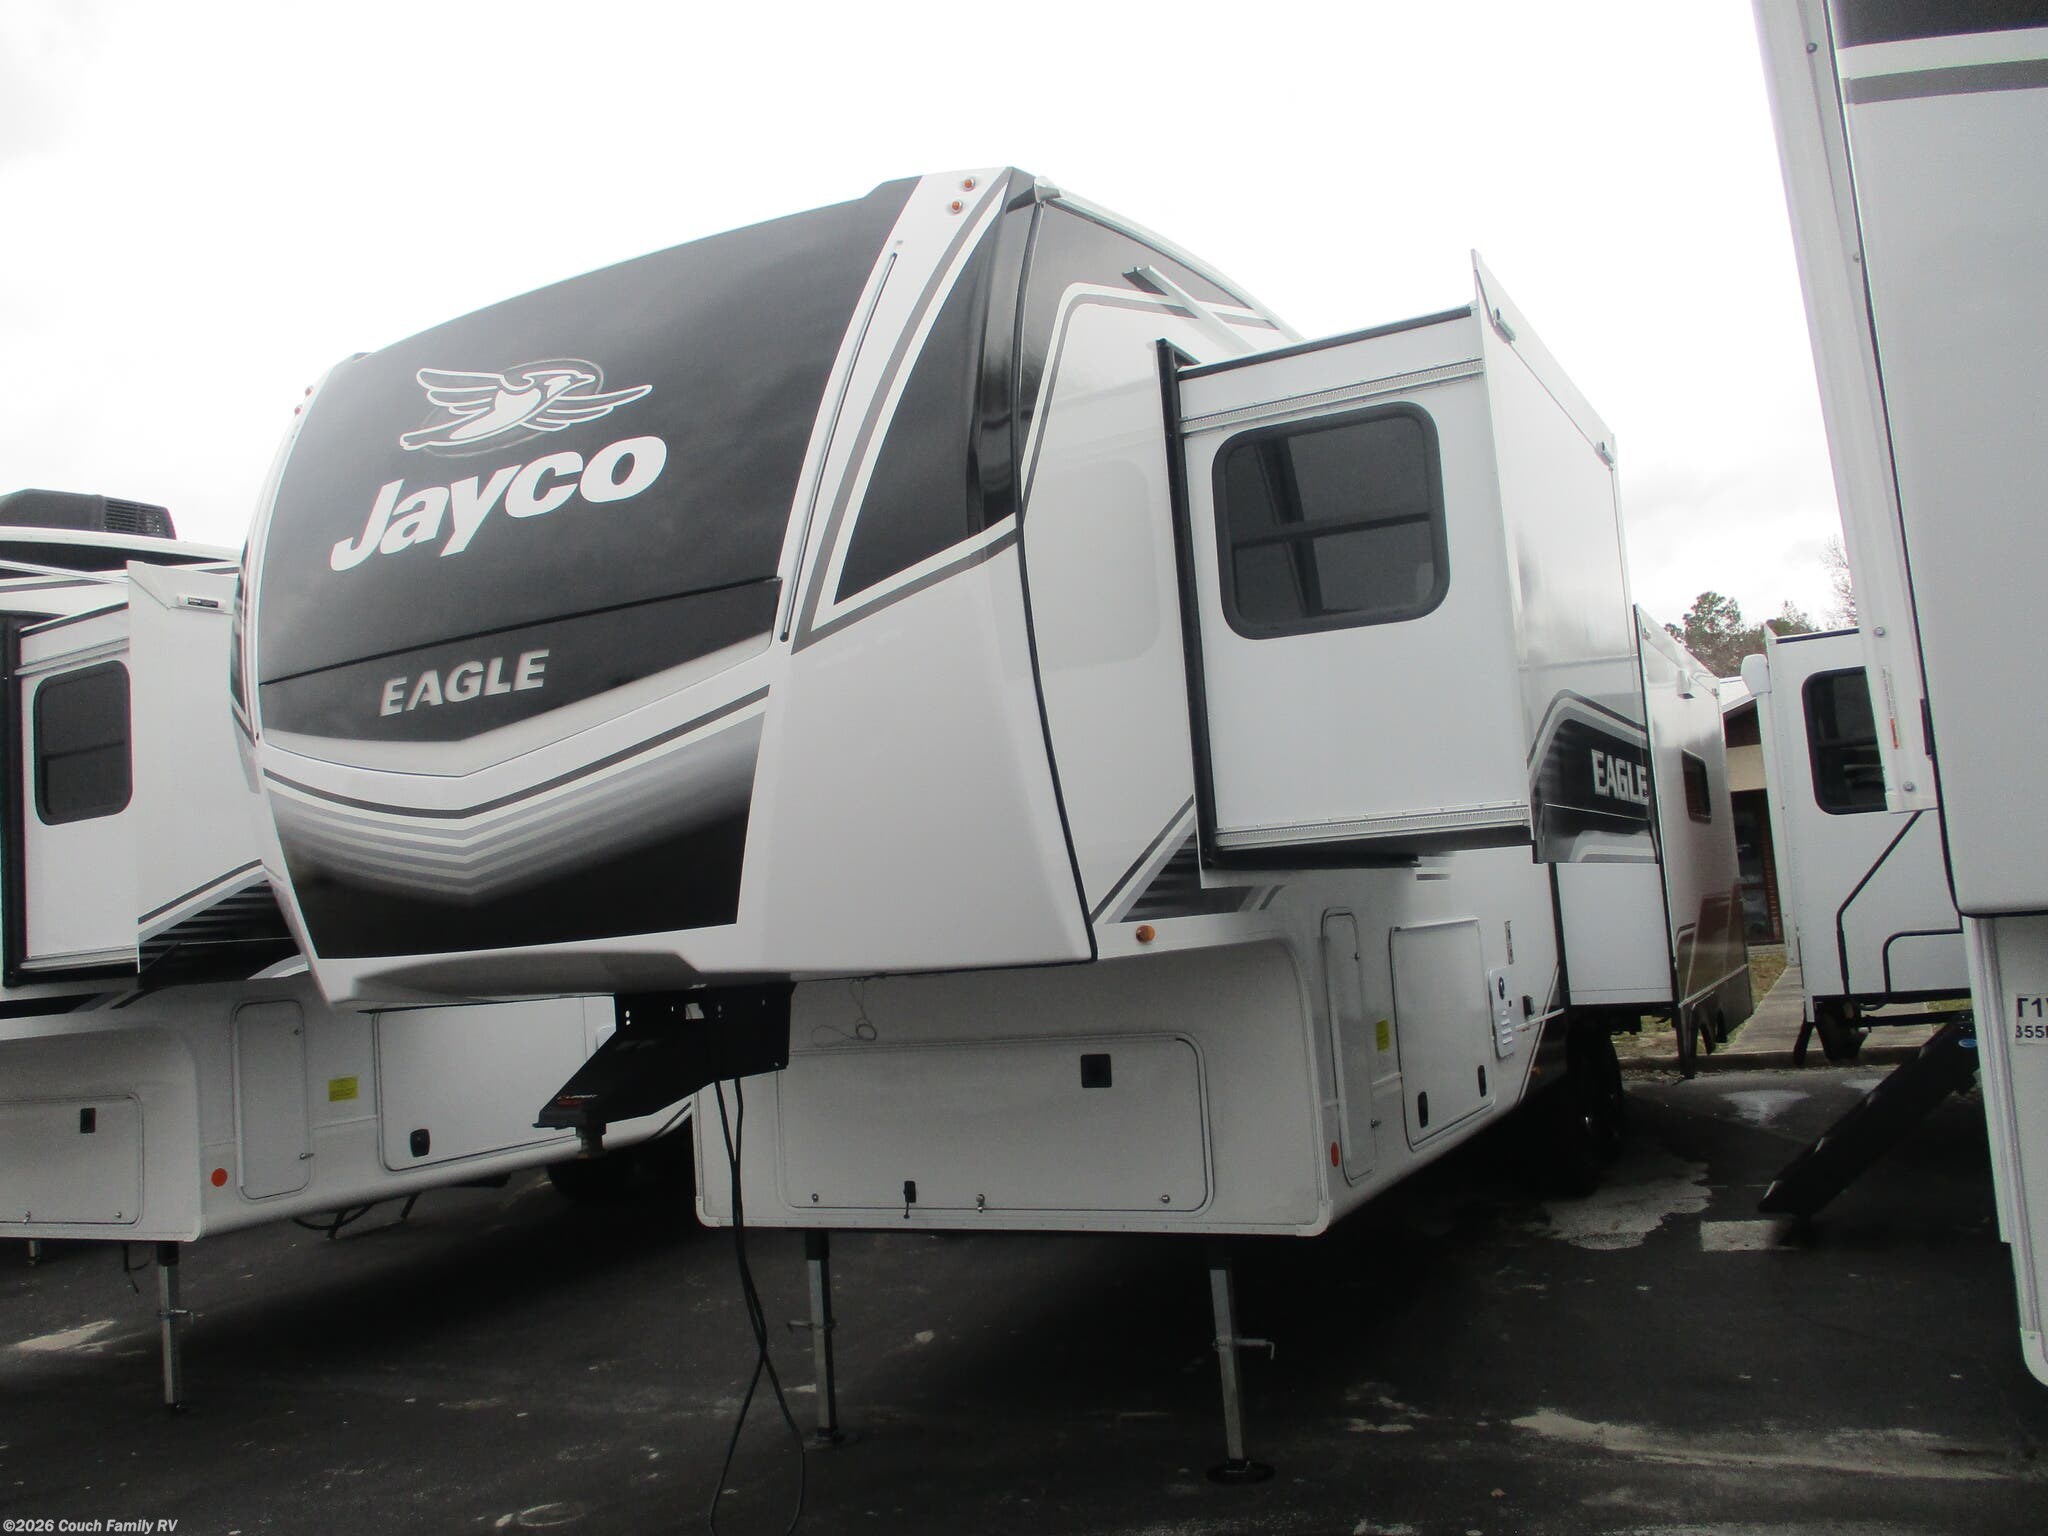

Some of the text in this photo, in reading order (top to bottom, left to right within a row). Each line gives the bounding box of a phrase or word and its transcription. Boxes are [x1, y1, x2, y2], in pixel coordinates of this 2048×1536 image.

[330, 436, 667, 571] Jayco
[379, 649, 550, 717] EAGLE
[1591, 748, 1649, 806] EAGLE
[2015, 1024, 2048, 1039] 355
